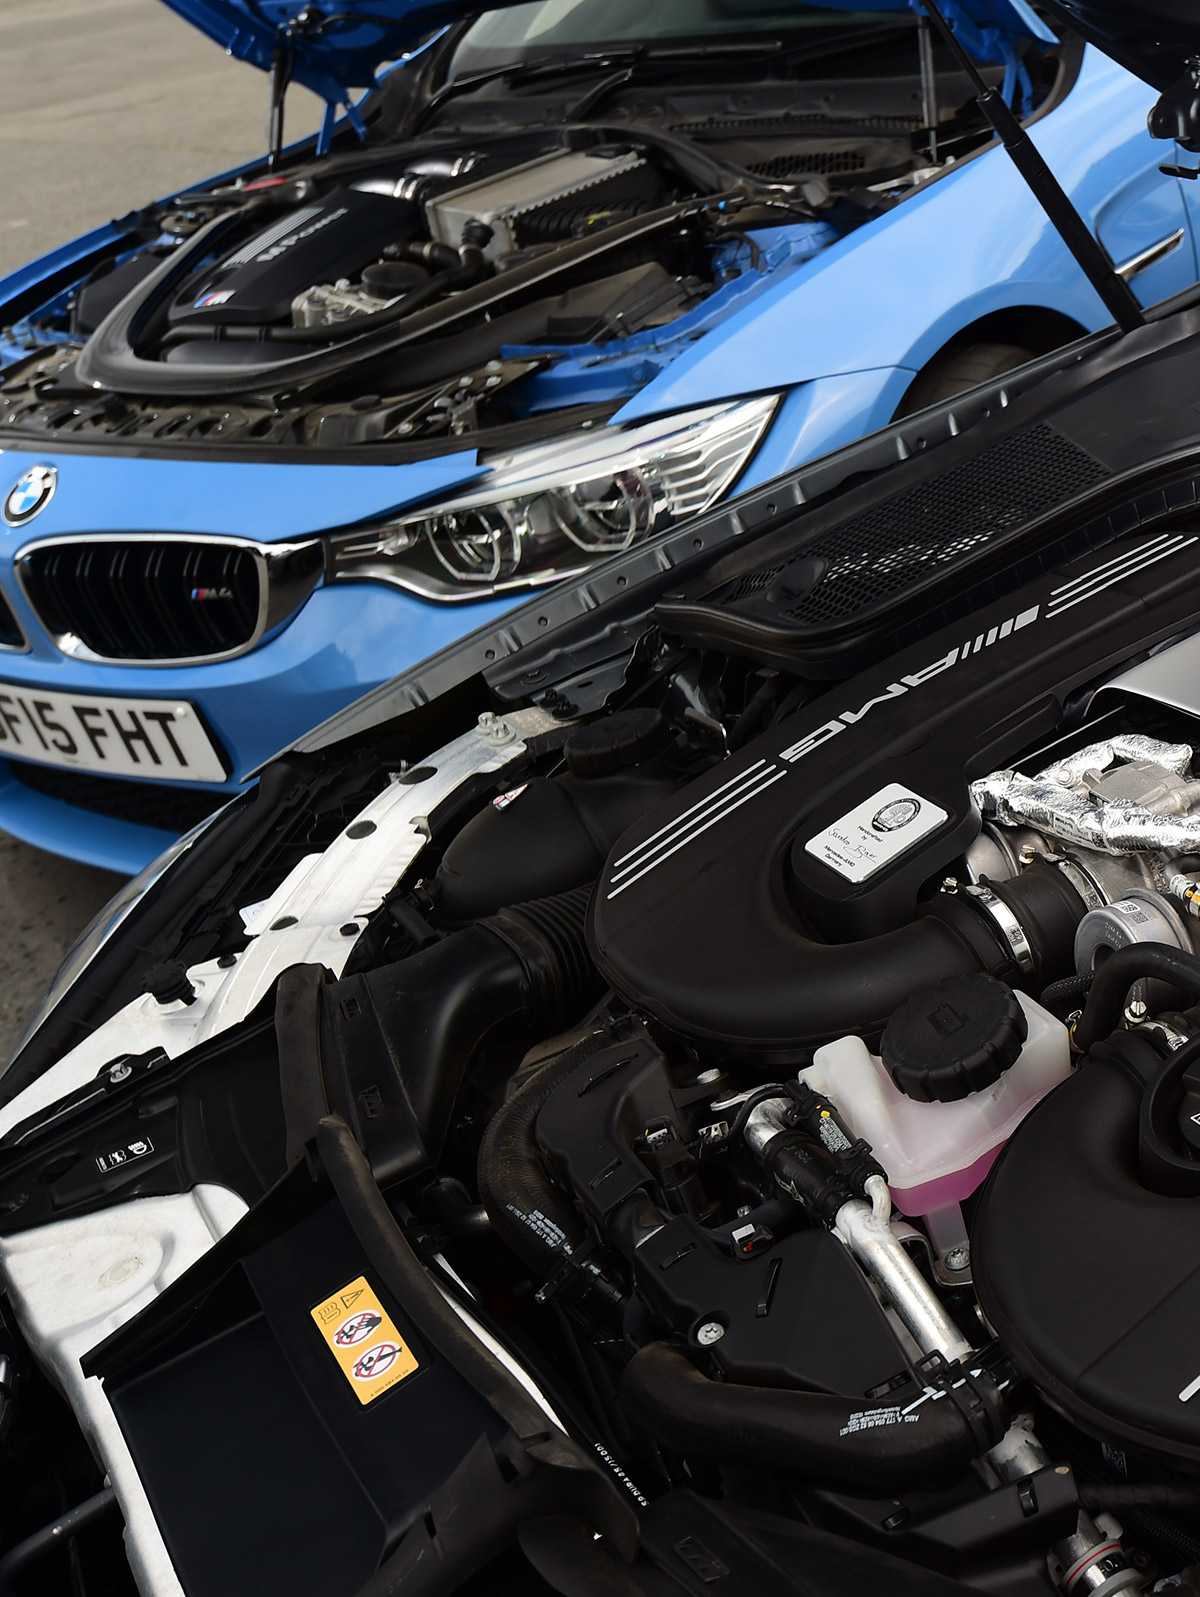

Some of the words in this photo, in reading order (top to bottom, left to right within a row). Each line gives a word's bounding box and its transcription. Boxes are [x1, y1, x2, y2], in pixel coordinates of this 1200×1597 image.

[0, 695, 78, 755] F15
[72, 705, 189, 767] FHT
[779, 647, 960, 762] AMG
